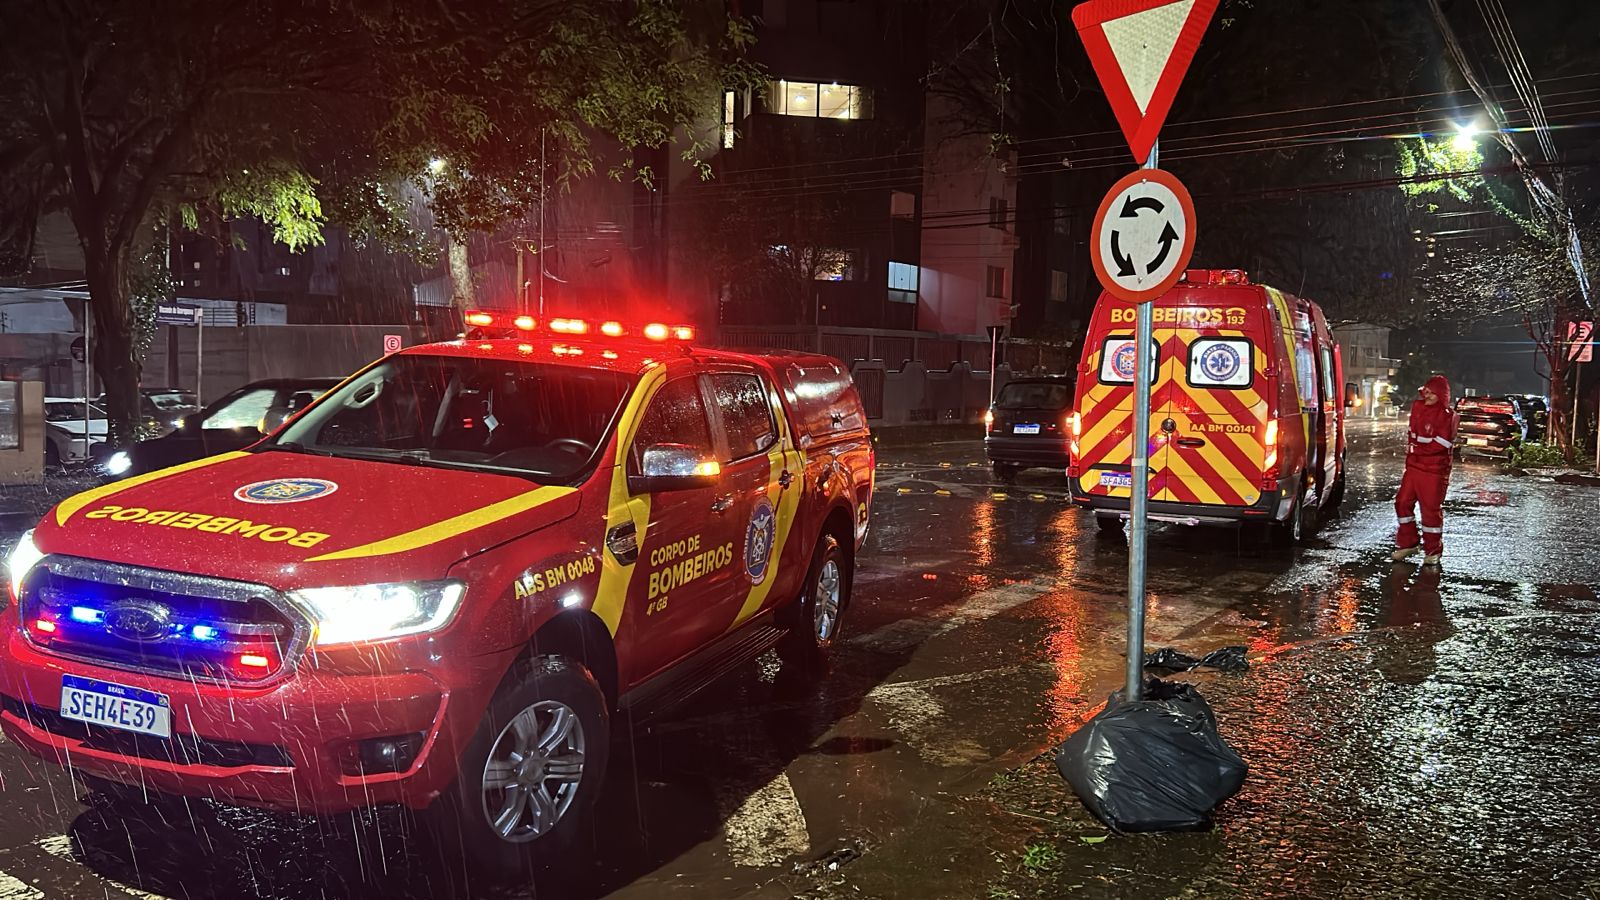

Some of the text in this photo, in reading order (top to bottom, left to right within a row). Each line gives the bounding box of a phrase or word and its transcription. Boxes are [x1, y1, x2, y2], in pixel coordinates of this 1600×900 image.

[1111, 307, 1223, 324] BOBEIROS
[1226, 315, 1245, 325] 193
[1191, 423, 1256, 434] AA BM 00141
[651, 534, 700, 567] CORPO DE
[514, 556, 595, 600] ABS BM 0048
[648, 542, 733, 600] BOMBEIROS
[656, 596, 668, 612] GB
[107, 685, 126, 695] BRASIL
[69, 691, 156, 730] SEH4E39
